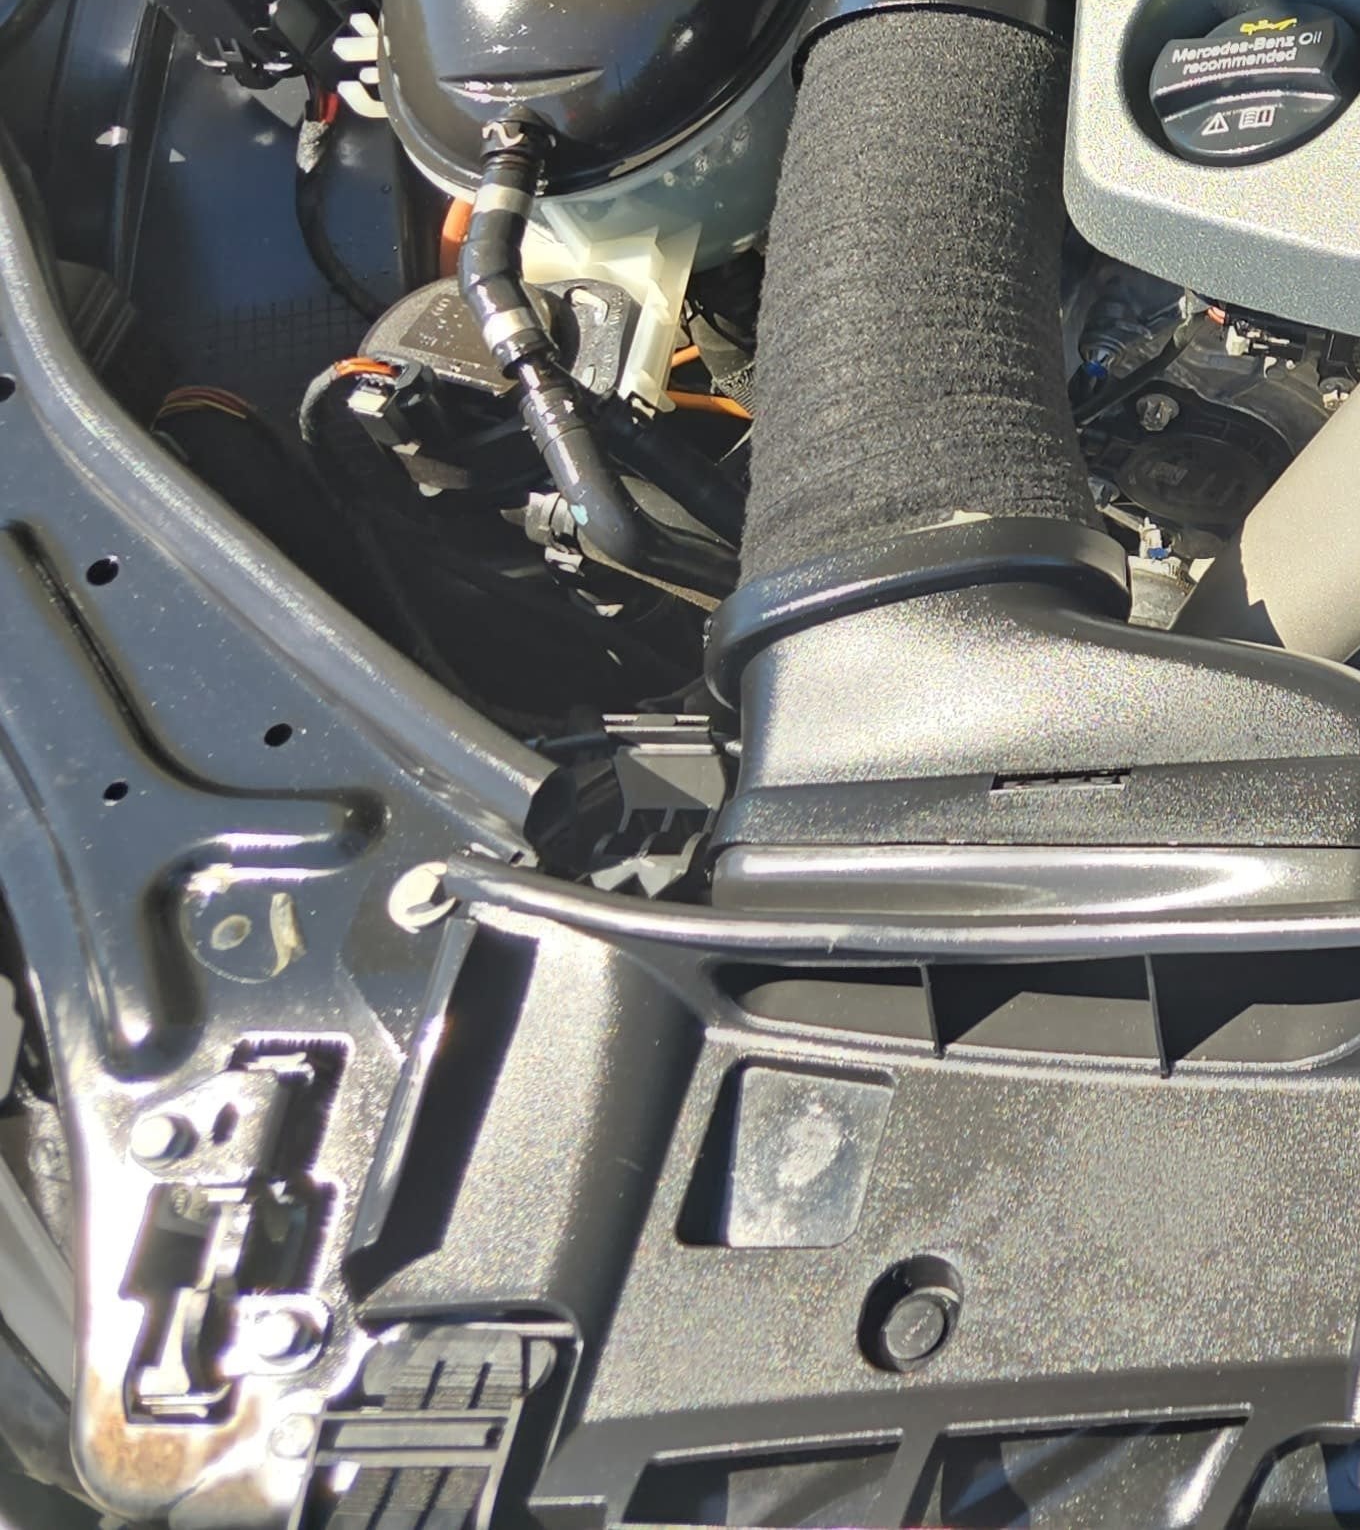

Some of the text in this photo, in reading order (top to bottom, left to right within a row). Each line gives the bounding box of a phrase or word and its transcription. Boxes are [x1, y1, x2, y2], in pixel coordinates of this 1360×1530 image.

[1172, 31, 1322, 63] Mercedes-Benz Oil
[1182, 48, 1297, 75] recommended
